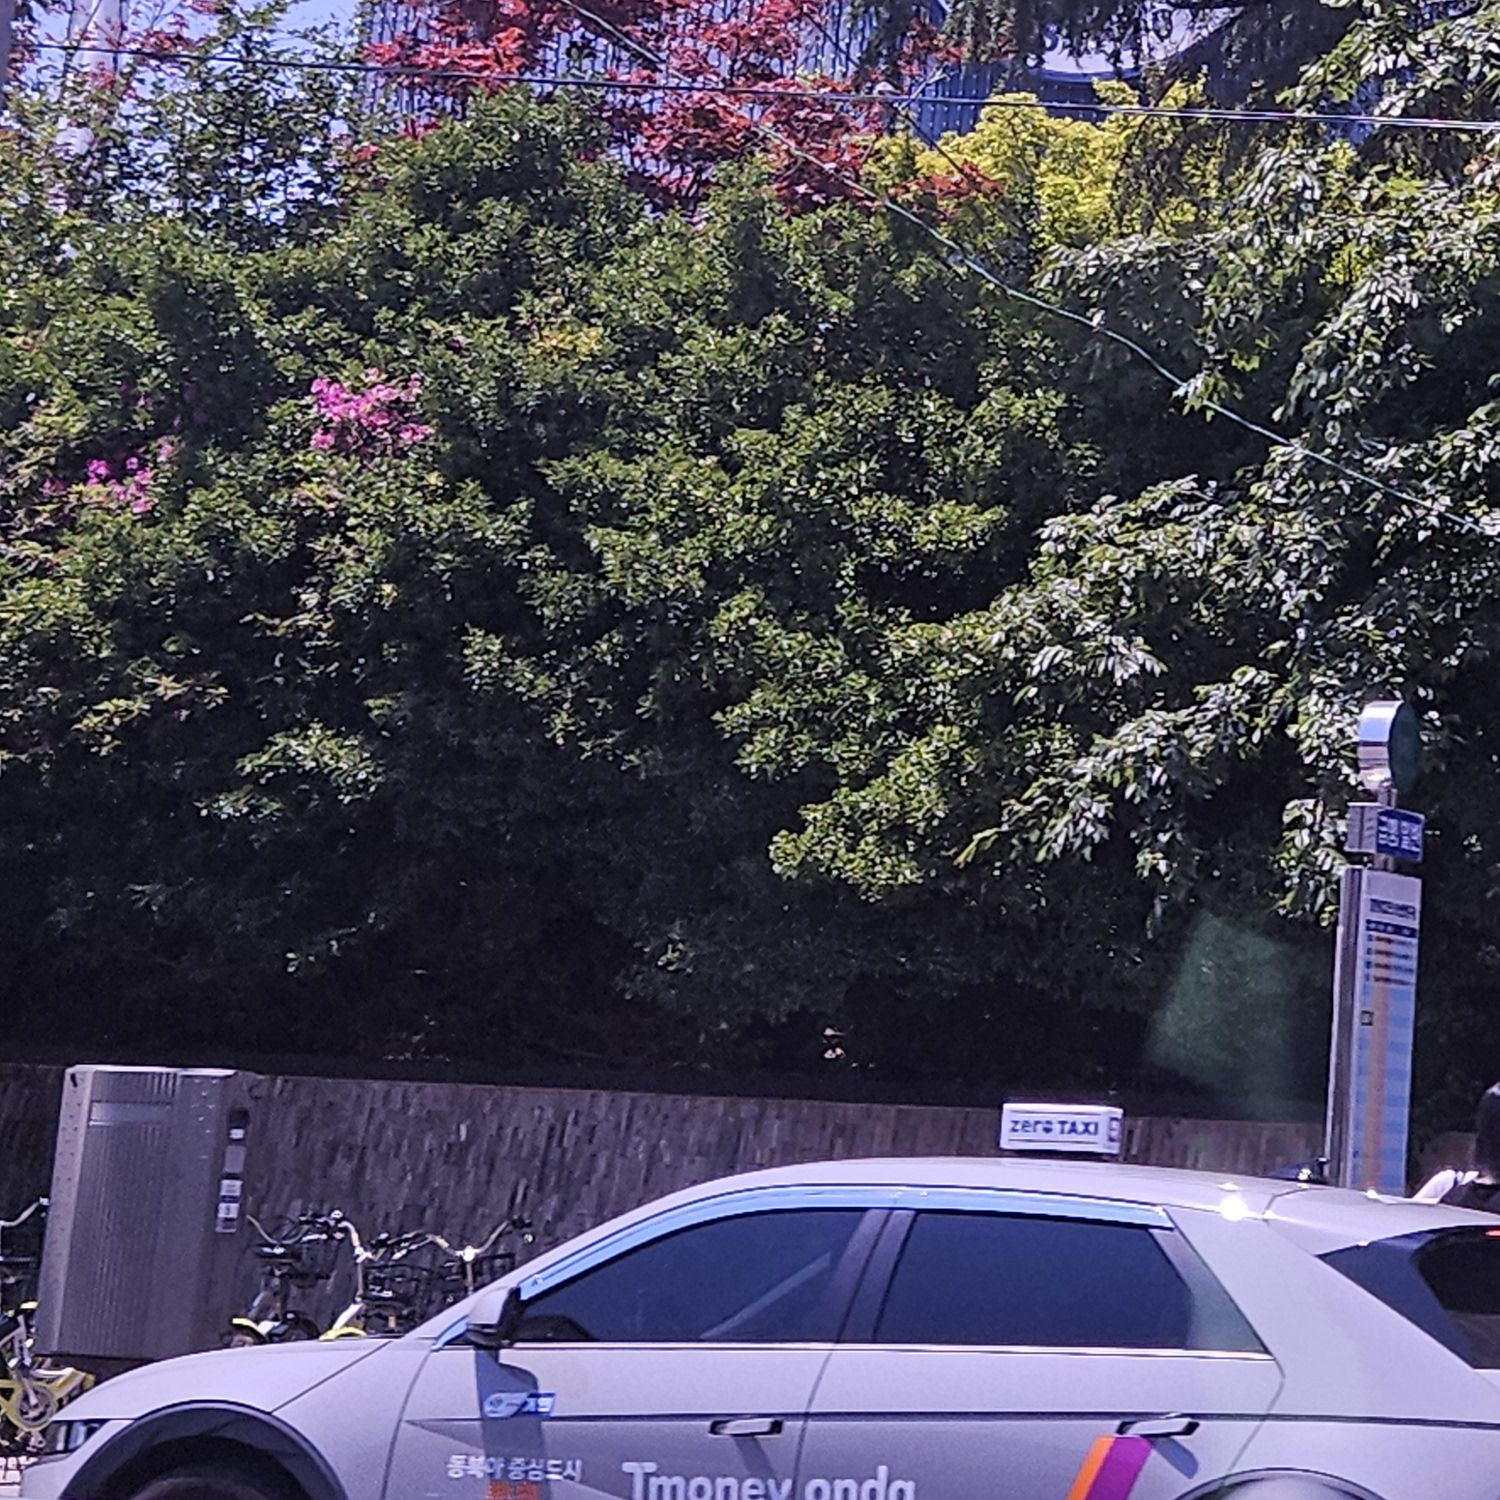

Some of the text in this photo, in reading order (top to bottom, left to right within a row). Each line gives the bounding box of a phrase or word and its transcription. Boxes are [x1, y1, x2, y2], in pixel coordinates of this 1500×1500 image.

[1058, 1120, 1099, 1136] TAXI
[507, 1457, 583, 1482] 중심도시
[621, 1462, 793, 1500] Tmoney
